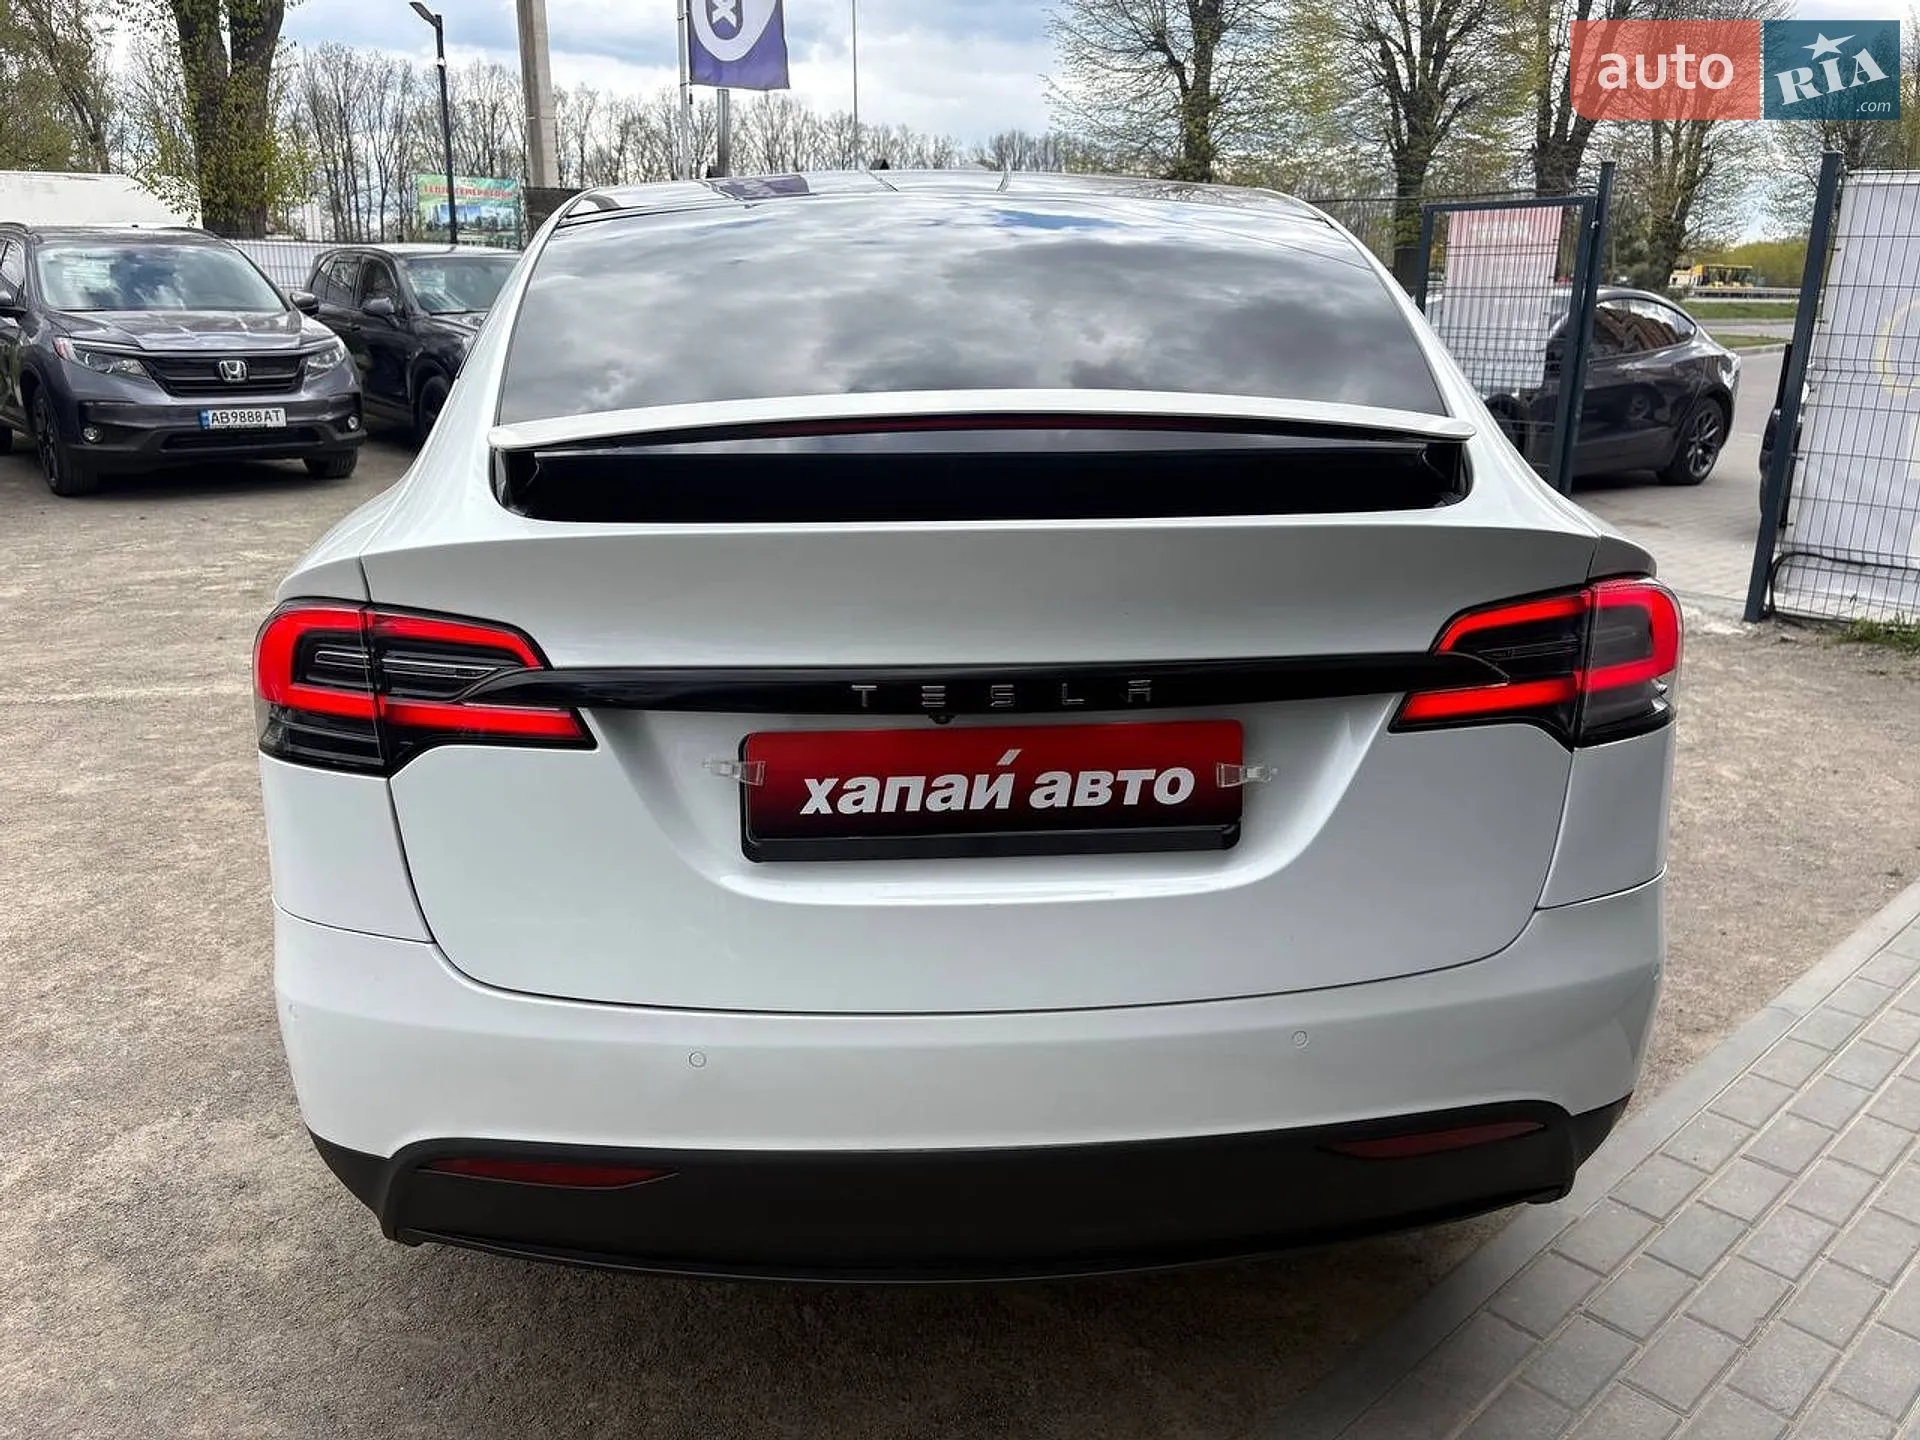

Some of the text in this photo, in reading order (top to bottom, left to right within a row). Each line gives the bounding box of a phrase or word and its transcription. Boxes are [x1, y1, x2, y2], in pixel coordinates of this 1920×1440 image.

[851, 678, 1154, 708] TESLA
[799, 748, 1196, 816] хапай авто
